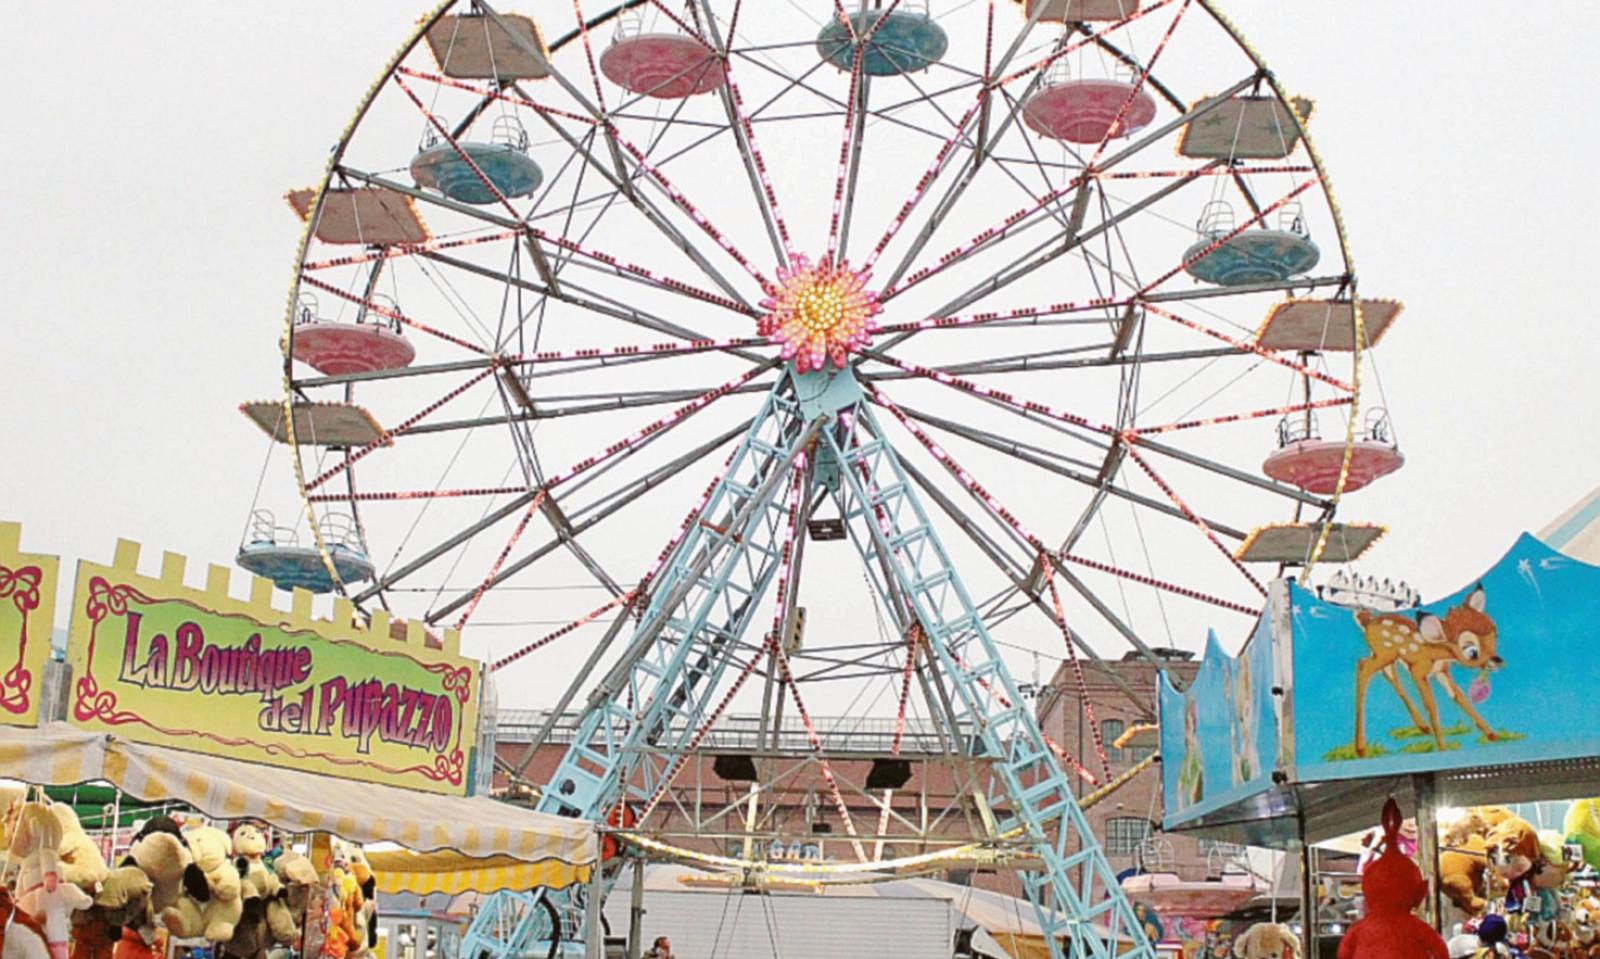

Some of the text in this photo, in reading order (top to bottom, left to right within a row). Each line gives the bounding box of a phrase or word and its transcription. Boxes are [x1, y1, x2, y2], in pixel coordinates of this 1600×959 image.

[118, 611, 313, 703] La Boutique
[258, 675, 452, 754] del Pupazzo
